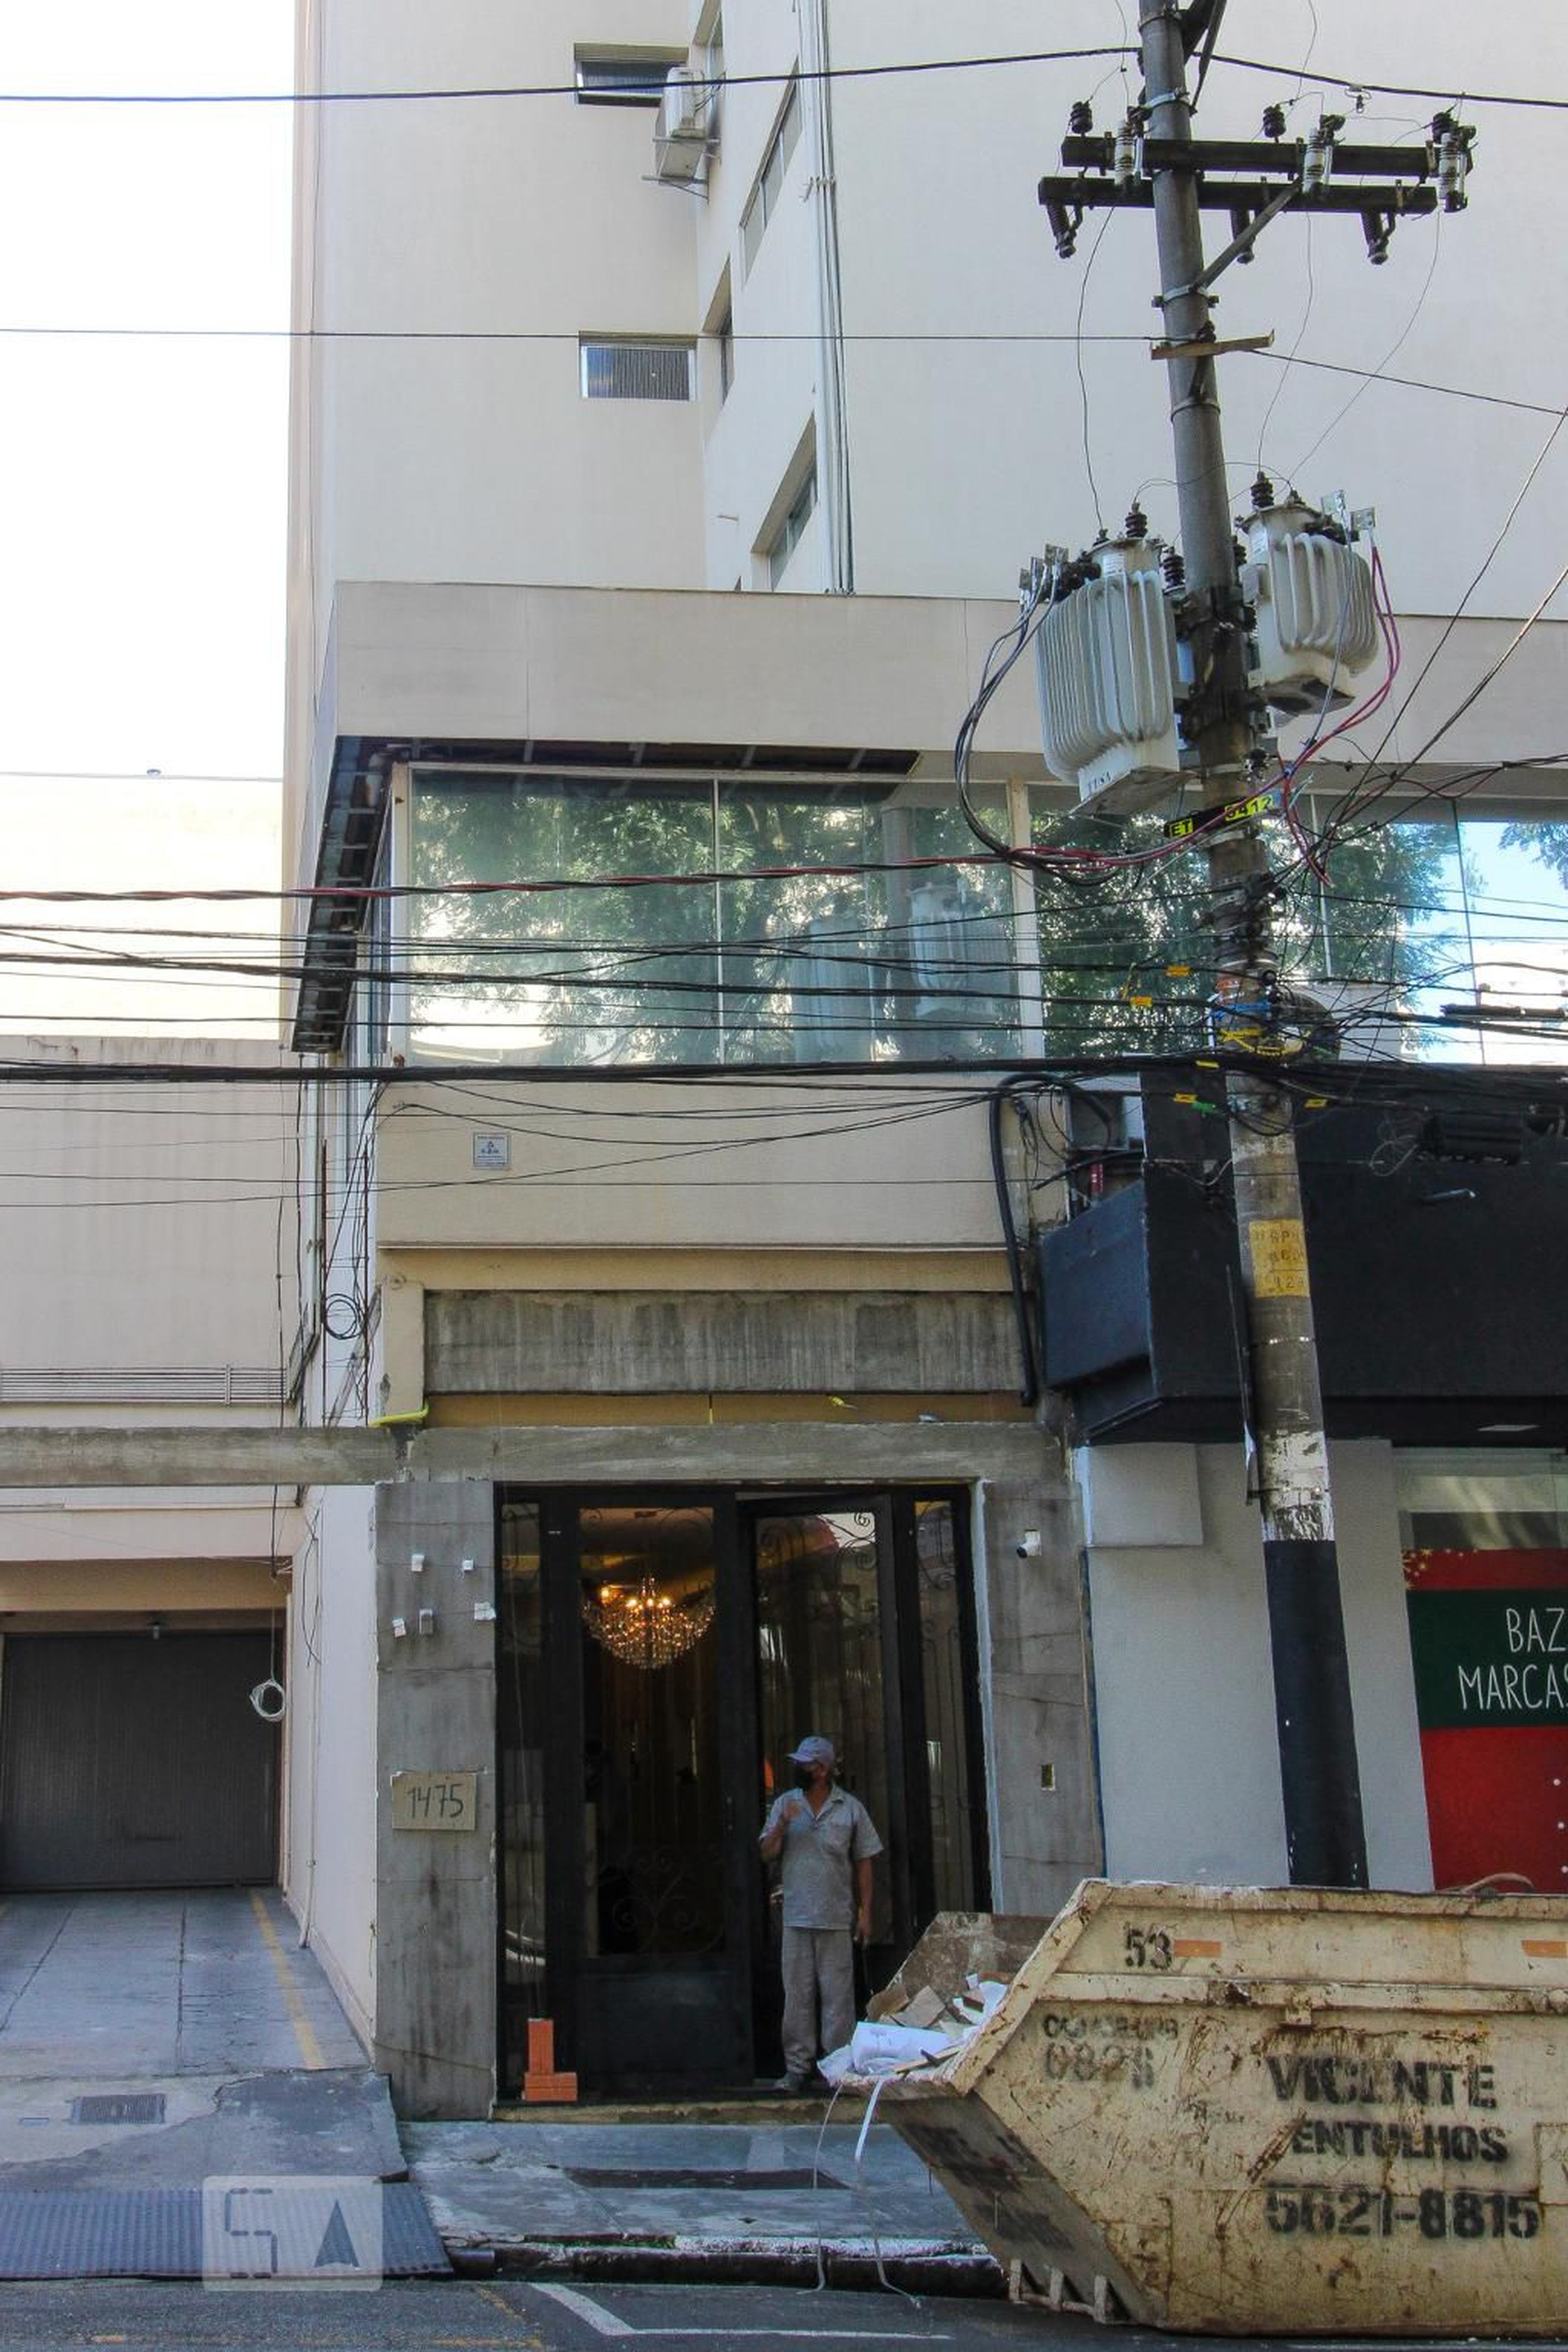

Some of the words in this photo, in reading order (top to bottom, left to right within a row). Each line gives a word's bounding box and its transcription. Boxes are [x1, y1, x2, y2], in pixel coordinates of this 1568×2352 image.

[1171, 820, 1191, 835] ET
[1458, 1663, 1568, 1710] MARCA
[408, 1783, 464, 1819] 1475
[1126, 1928, 1172, 1971] 53
[1267, 2055, 1498, 2109] VICENTE
[1292, 2120, 1508, 2162] ENTULHOS
[1266, 2182, 1539, 2238] 5621-8815
